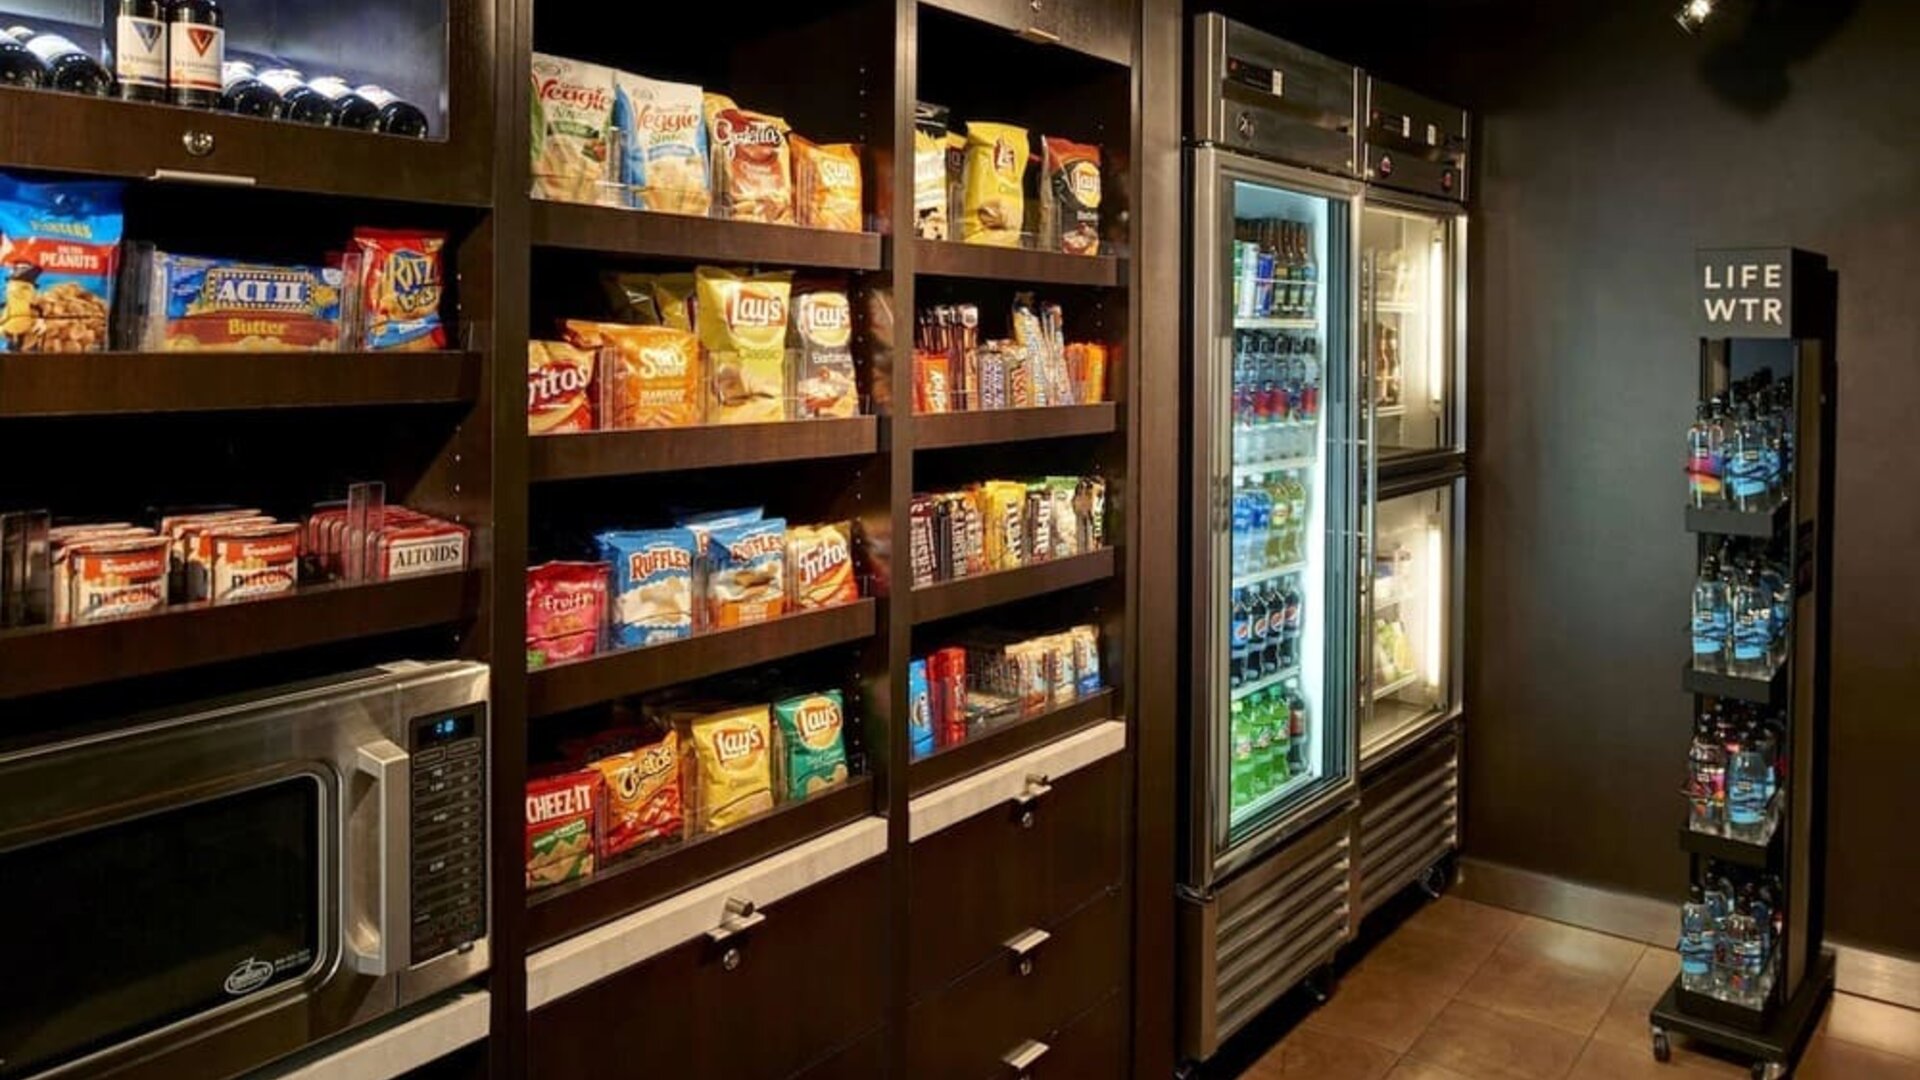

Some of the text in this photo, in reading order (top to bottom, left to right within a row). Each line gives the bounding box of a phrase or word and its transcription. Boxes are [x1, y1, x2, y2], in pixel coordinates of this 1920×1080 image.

[40, 251, 99, 270] PEANUTS
[1704, 264, 1783, 289] LIFE
[217, 279, 268, 303] ACT
[273, 281, 302, 304] II
[731, 286, 783, 326] Lay's
[808, 302, 850, 329] Lay's
[1704, 298, 1783, 325] WTR
[228, 318, 286, 336] Butter
[394, 544, 460, 569] ALTOIDS
[630, 547, 691, 582] RUFFLES
[799, 536, 848, 584] Fritos
[800, 703, 840, 738] Lay's
[715, 724, 762, 763] Lay's
[526, 786, 591, 824] CHEEZ-IT
